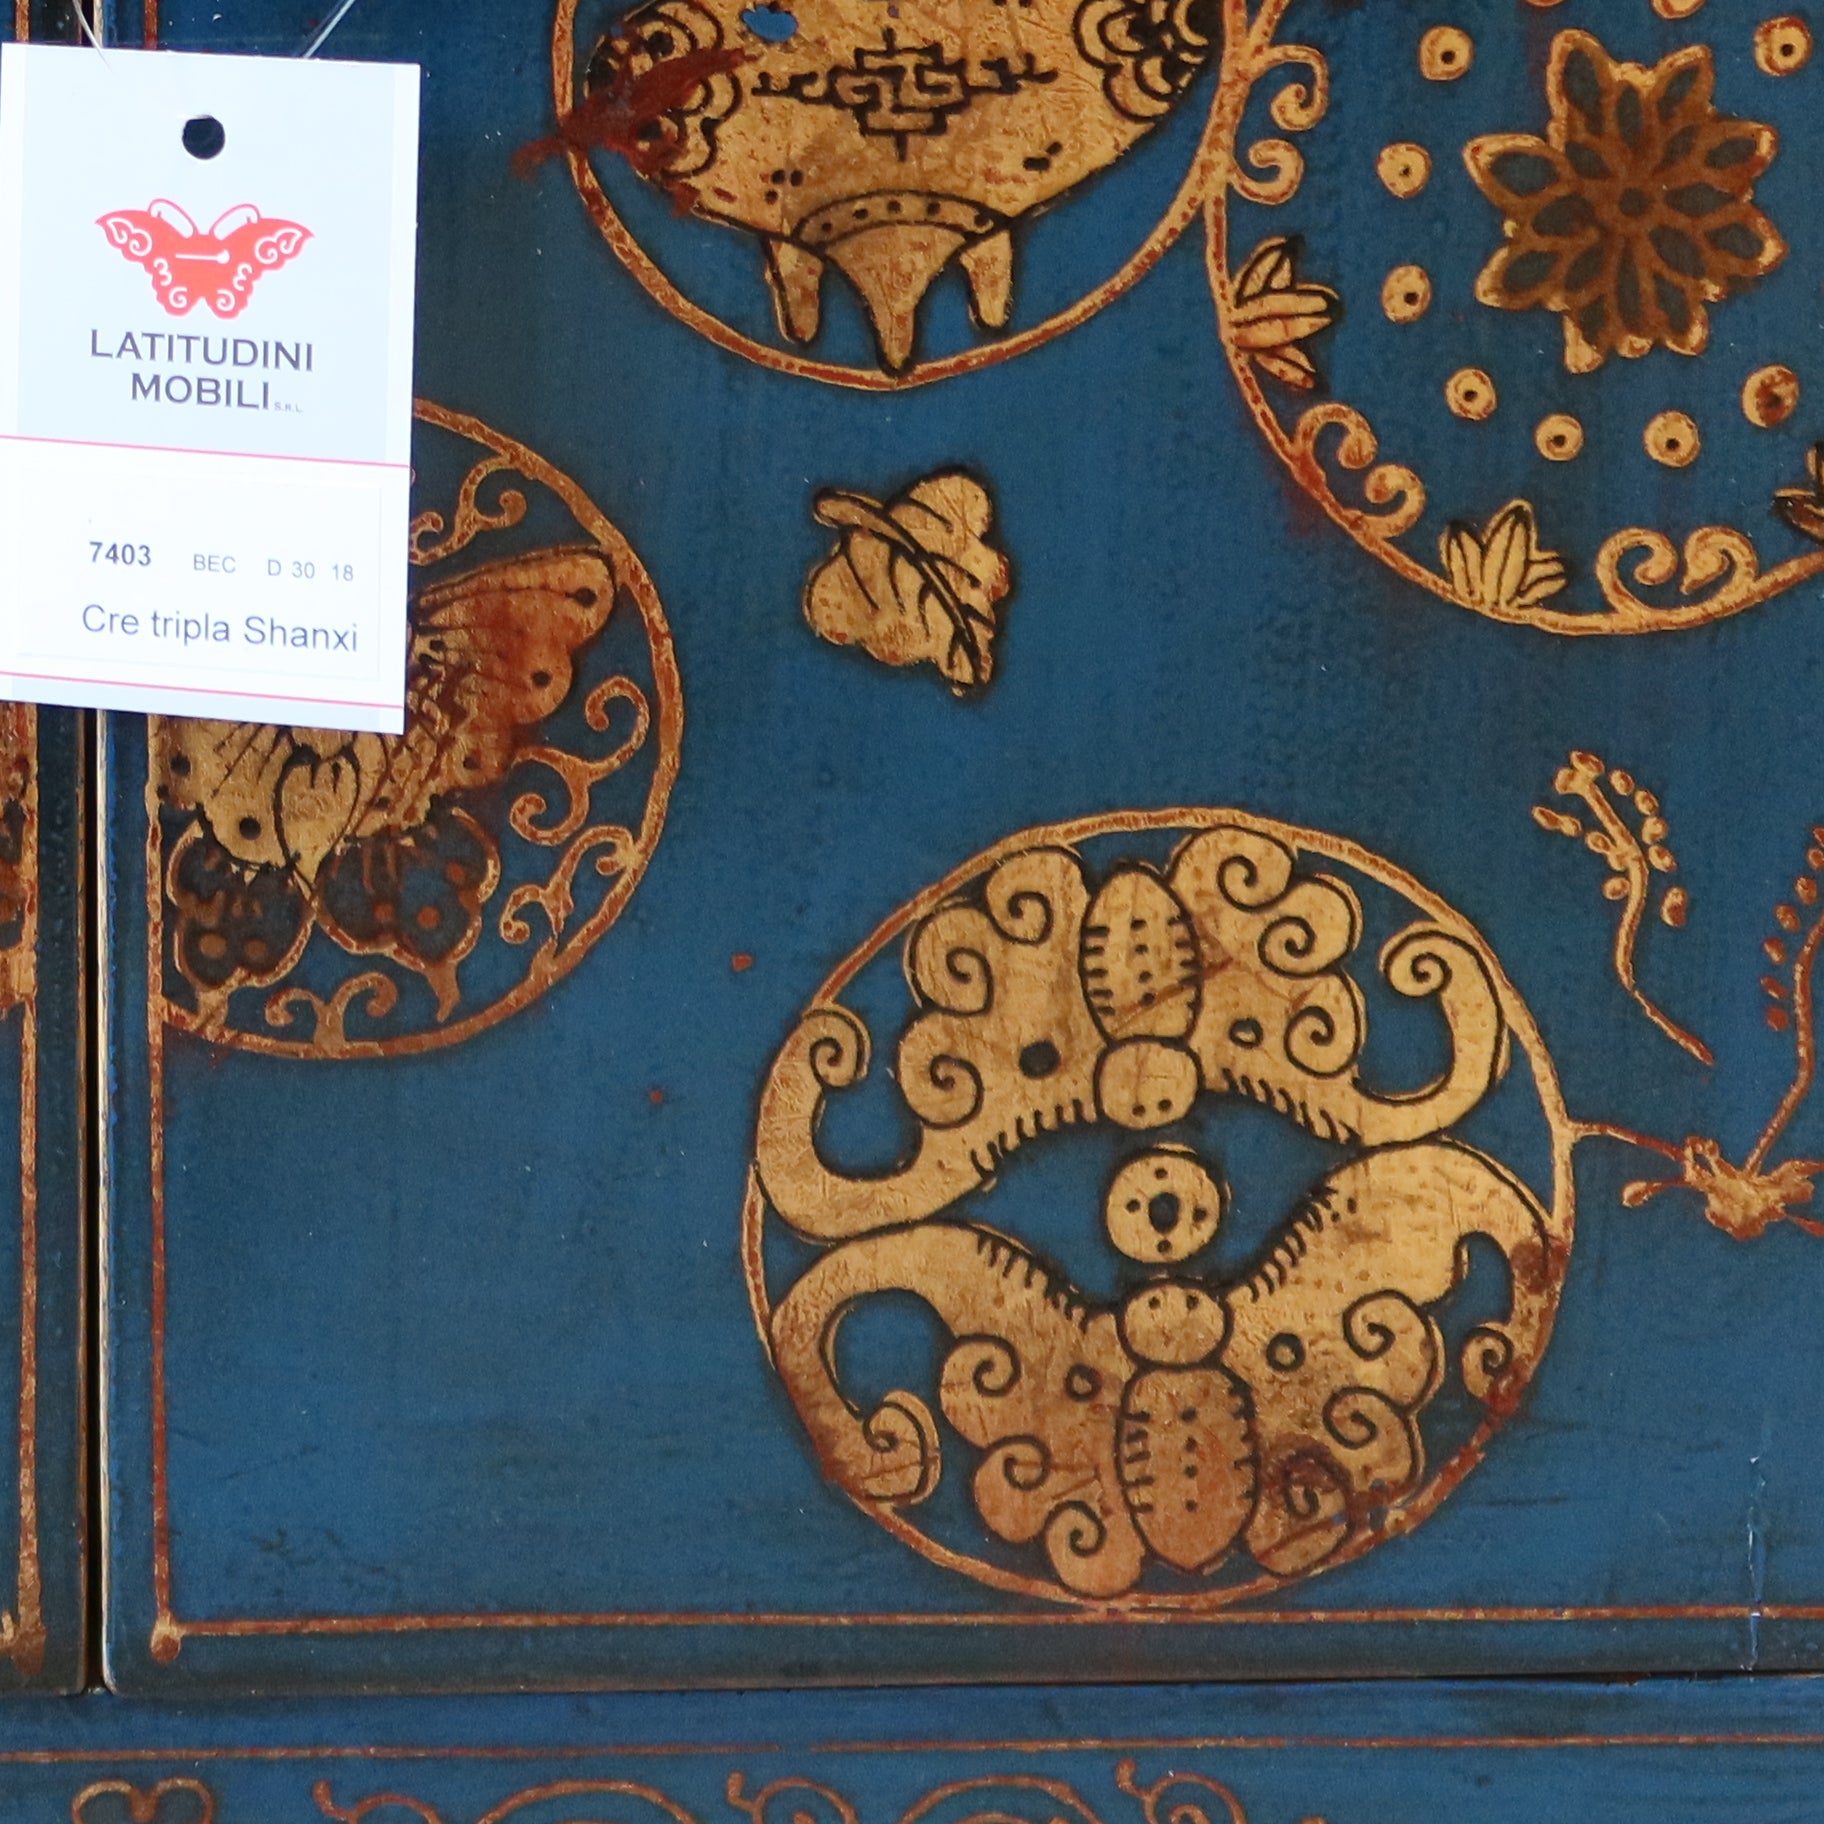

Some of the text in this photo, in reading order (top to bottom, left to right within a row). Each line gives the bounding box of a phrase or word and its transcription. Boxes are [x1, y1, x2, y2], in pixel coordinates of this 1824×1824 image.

[90, 328, 314, 372] LATITUDINI
[130, 372, 270, 410] MOBILI
[88, 540, 354, 582] 7403 BEC D 30 18
[81, 603, 358, 652] Cre tripla Shanxi
